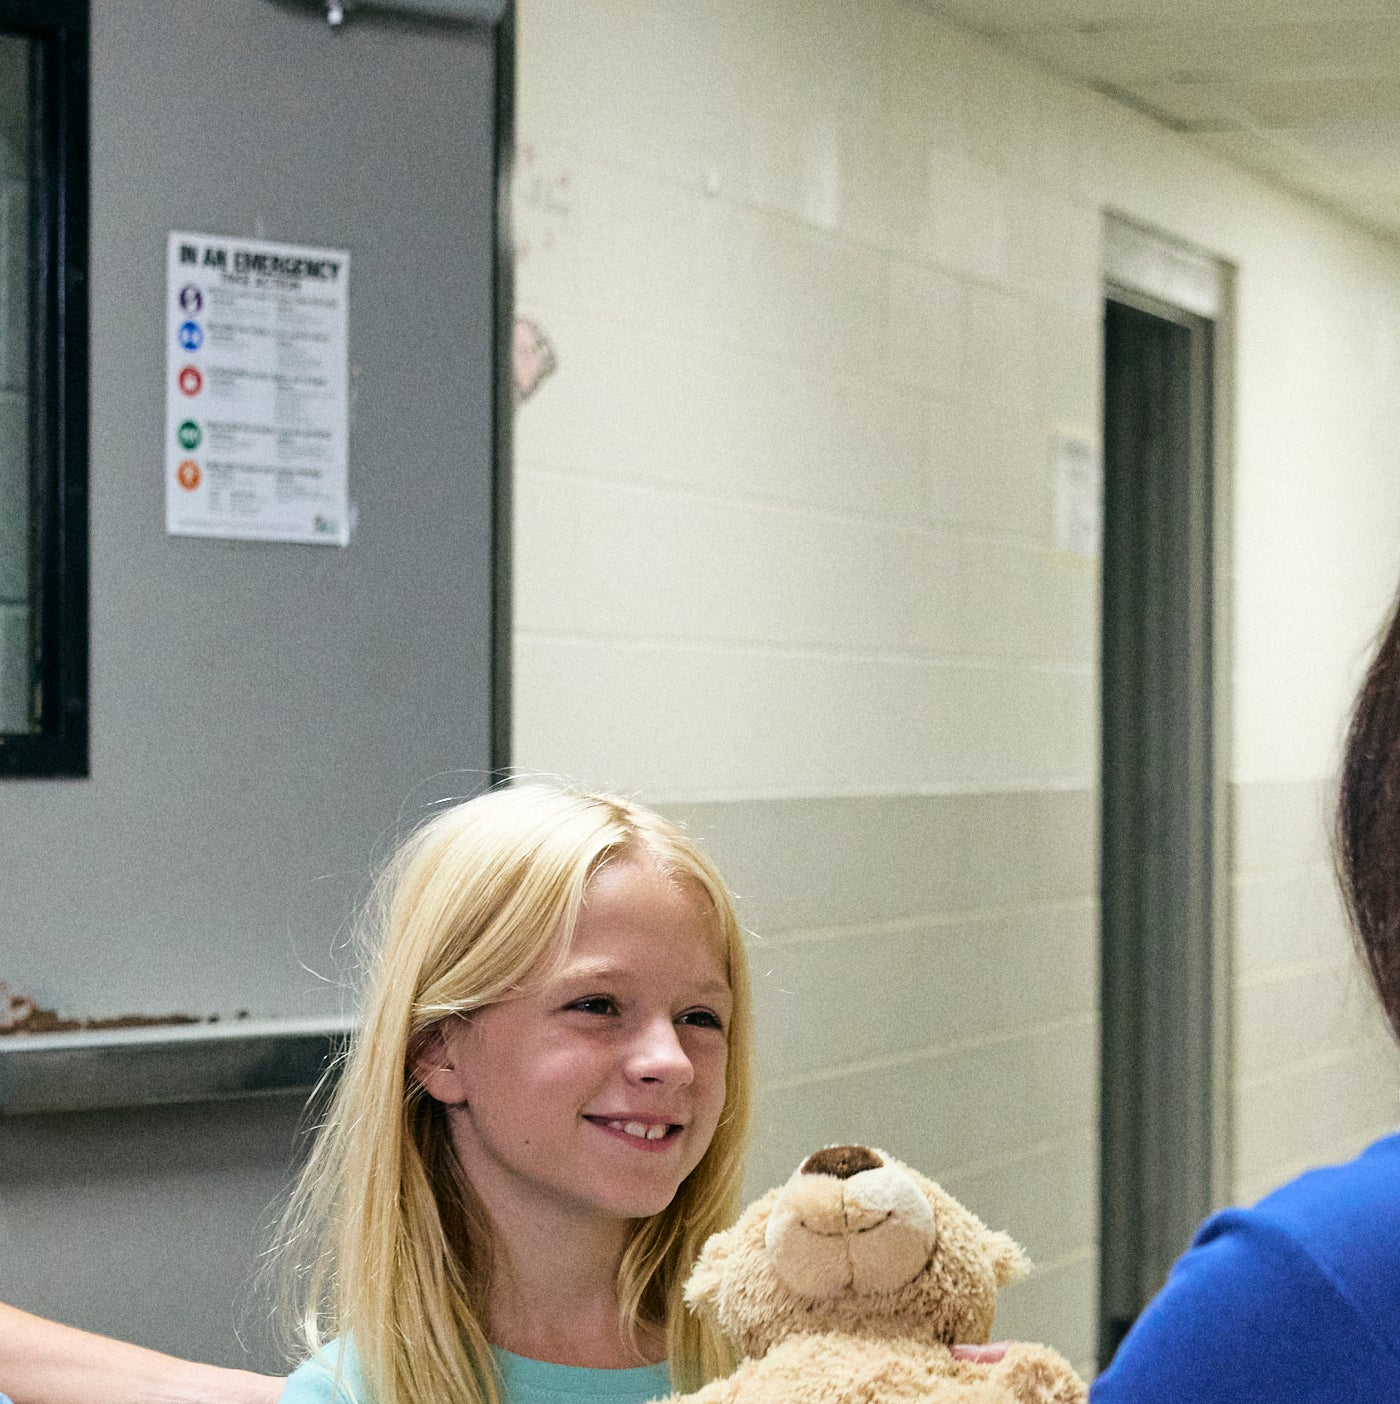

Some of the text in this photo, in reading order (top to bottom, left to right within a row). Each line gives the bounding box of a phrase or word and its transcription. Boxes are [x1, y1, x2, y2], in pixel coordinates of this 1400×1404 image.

[179, 244, 340, 280] IN AN EMERGENCY
